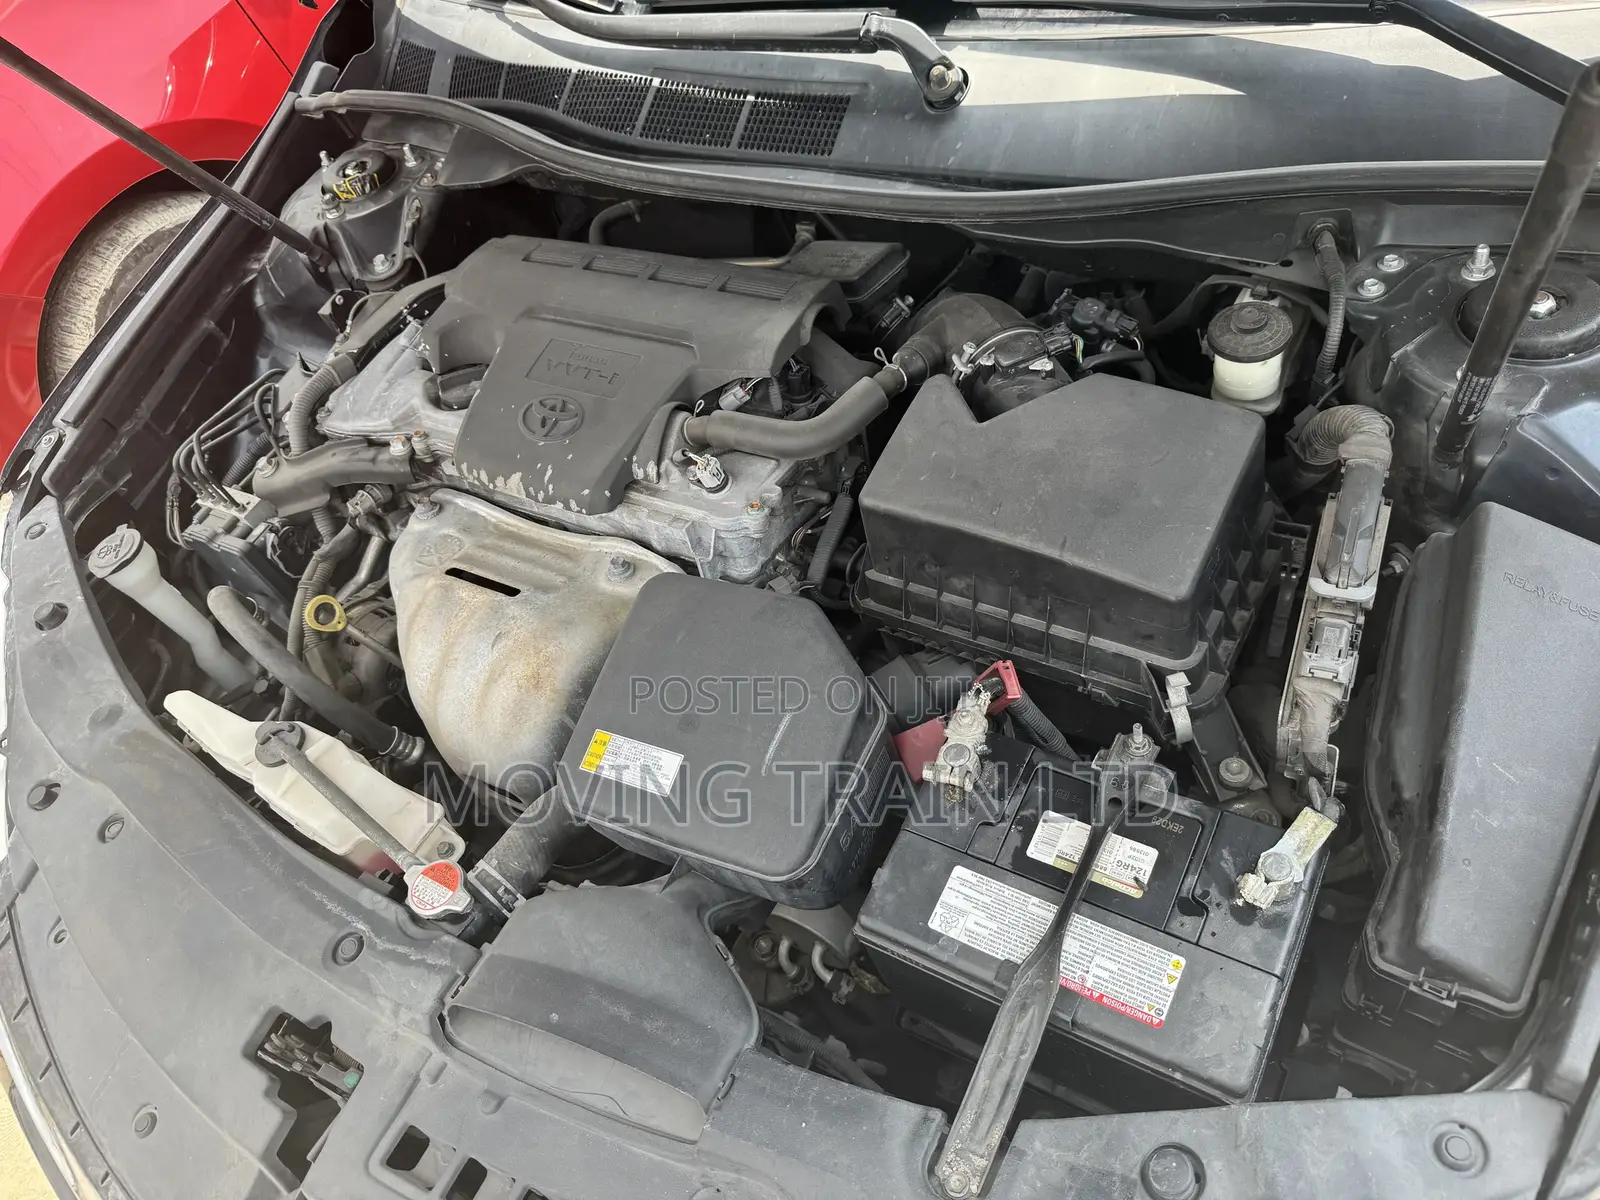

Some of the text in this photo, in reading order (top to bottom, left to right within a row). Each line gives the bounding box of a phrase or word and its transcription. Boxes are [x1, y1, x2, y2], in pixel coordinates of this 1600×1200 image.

[1116, 859, 1147, 876] 124RG
[1058, 975, 1091, 996] PELIGRO/VE
[1102, 994, 1152, 1023] DANGER/POISON
